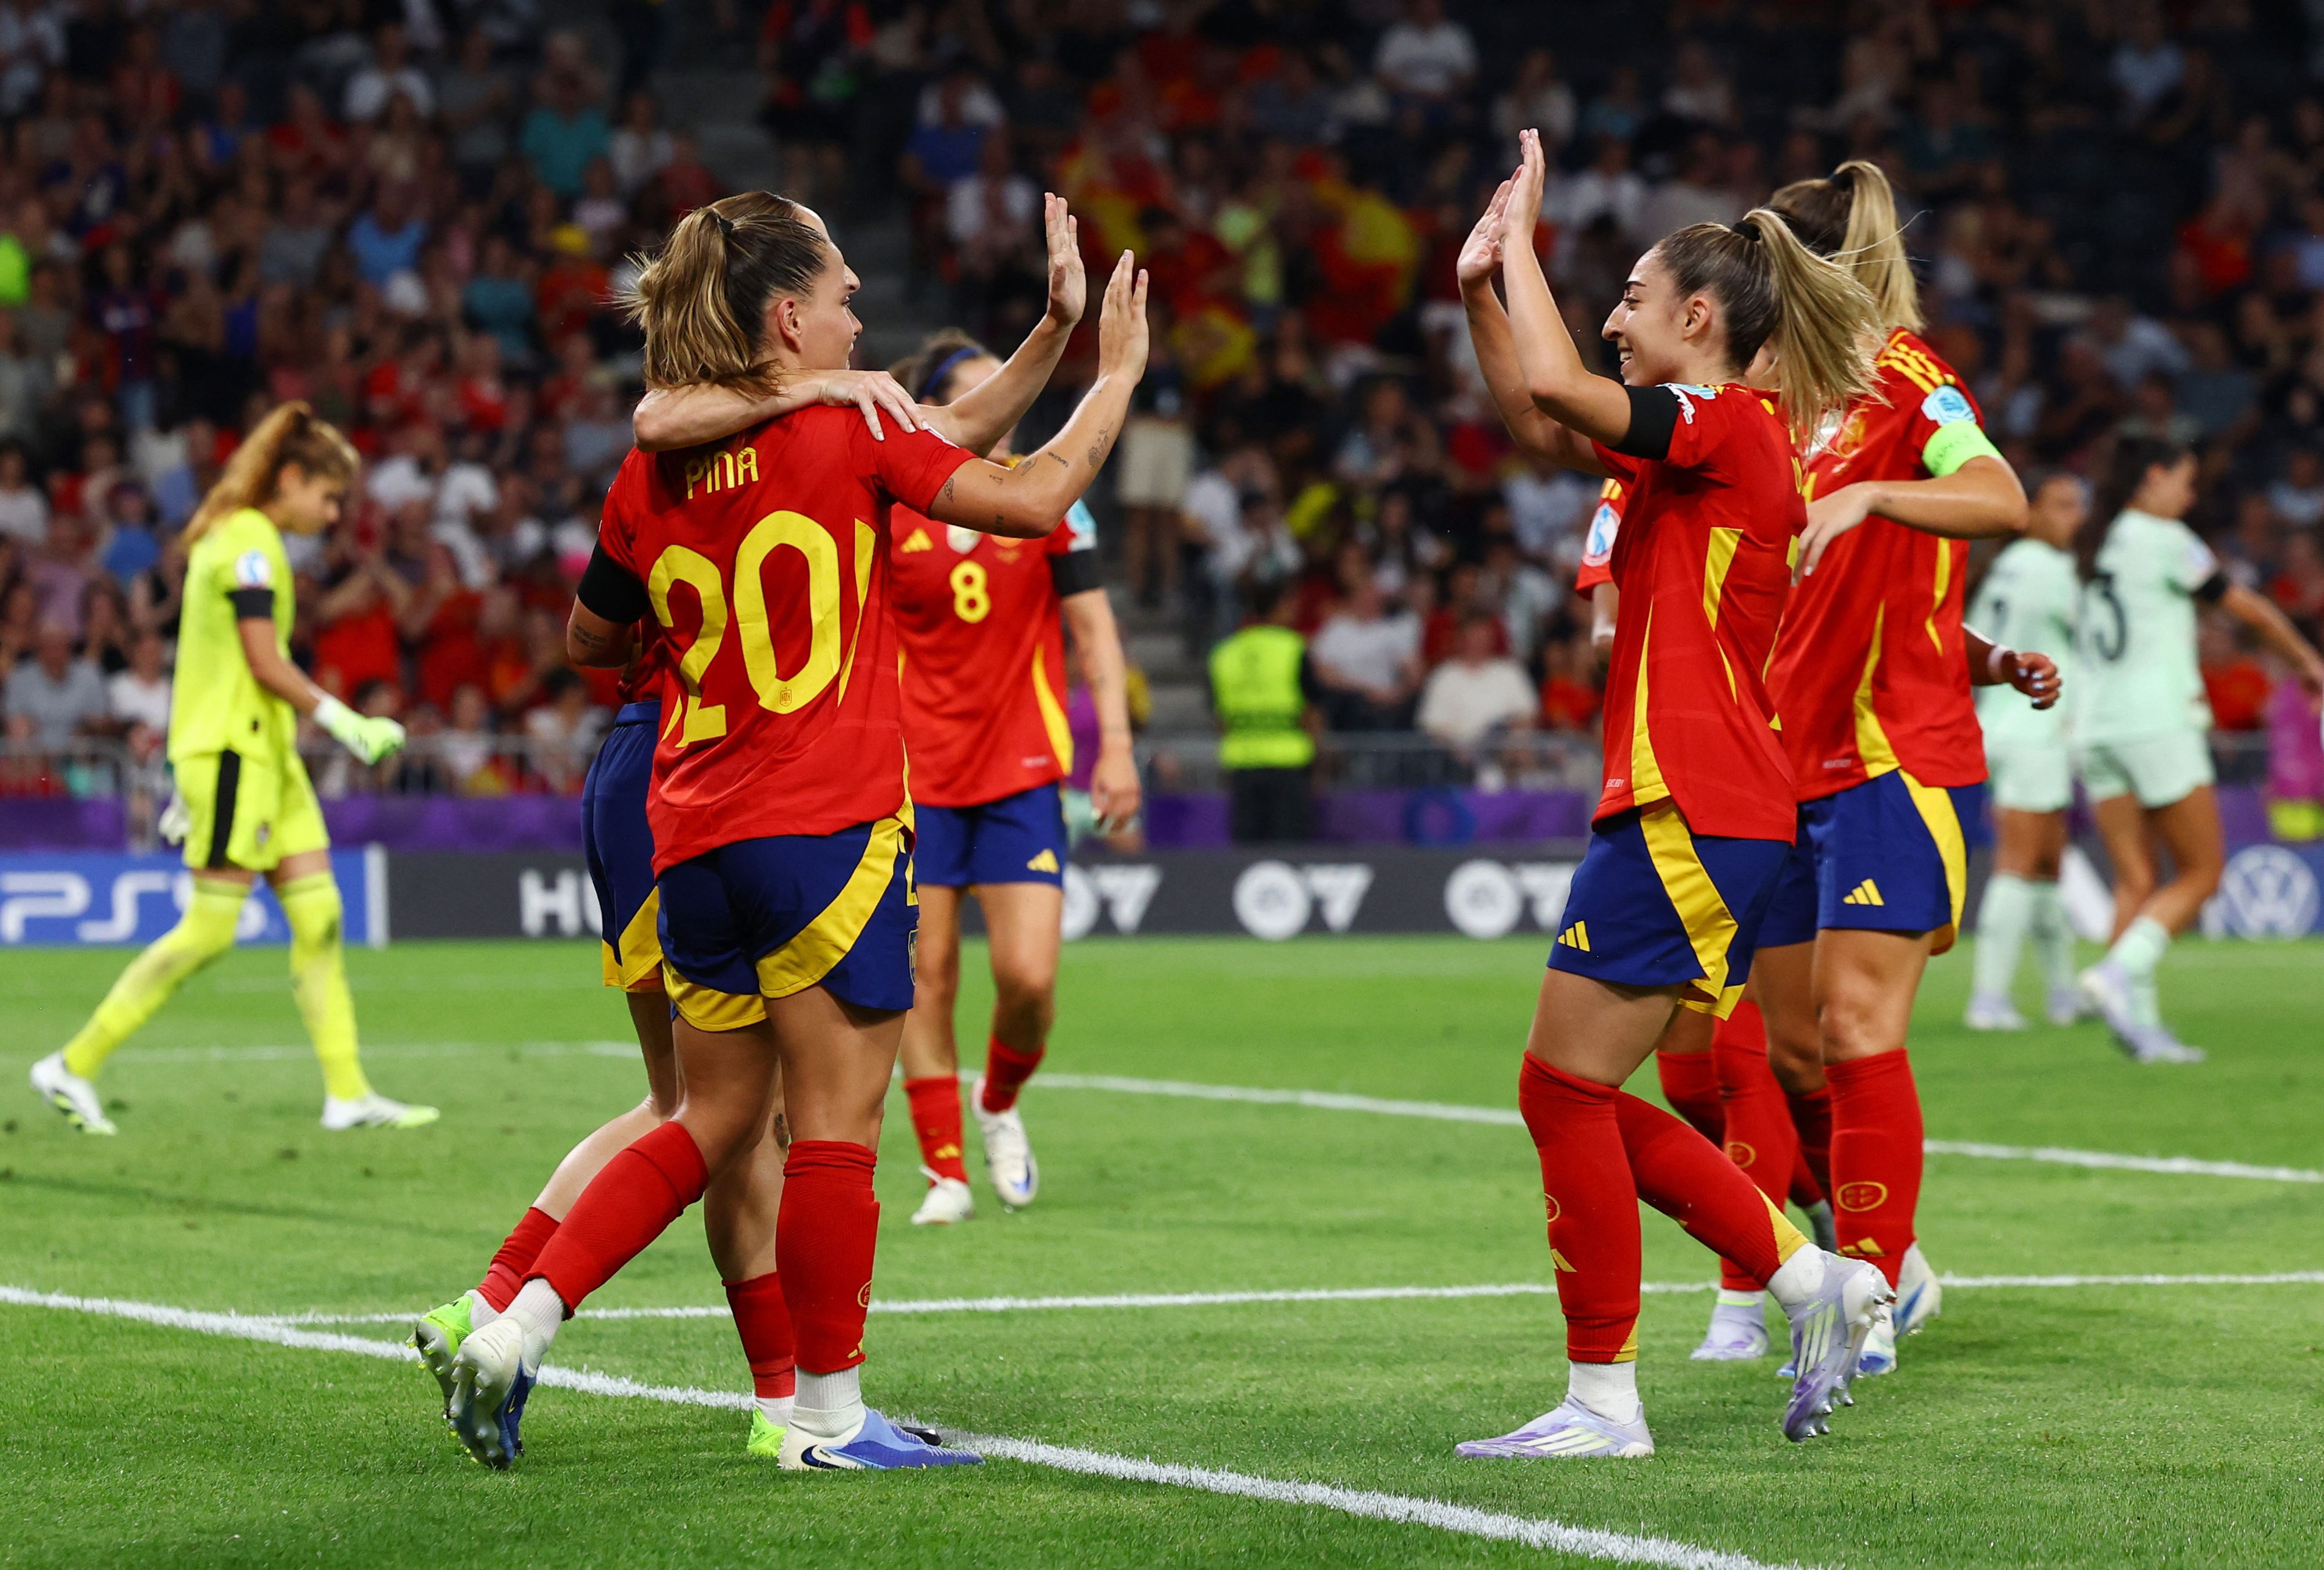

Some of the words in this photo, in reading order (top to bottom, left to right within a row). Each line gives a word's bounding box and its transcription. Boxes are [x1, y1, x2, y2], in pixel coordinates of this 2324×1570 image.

[685, 446, 759, 500] PINA
[949, 559, 991, 624] 8
[648, 510, 841, 748] 20
